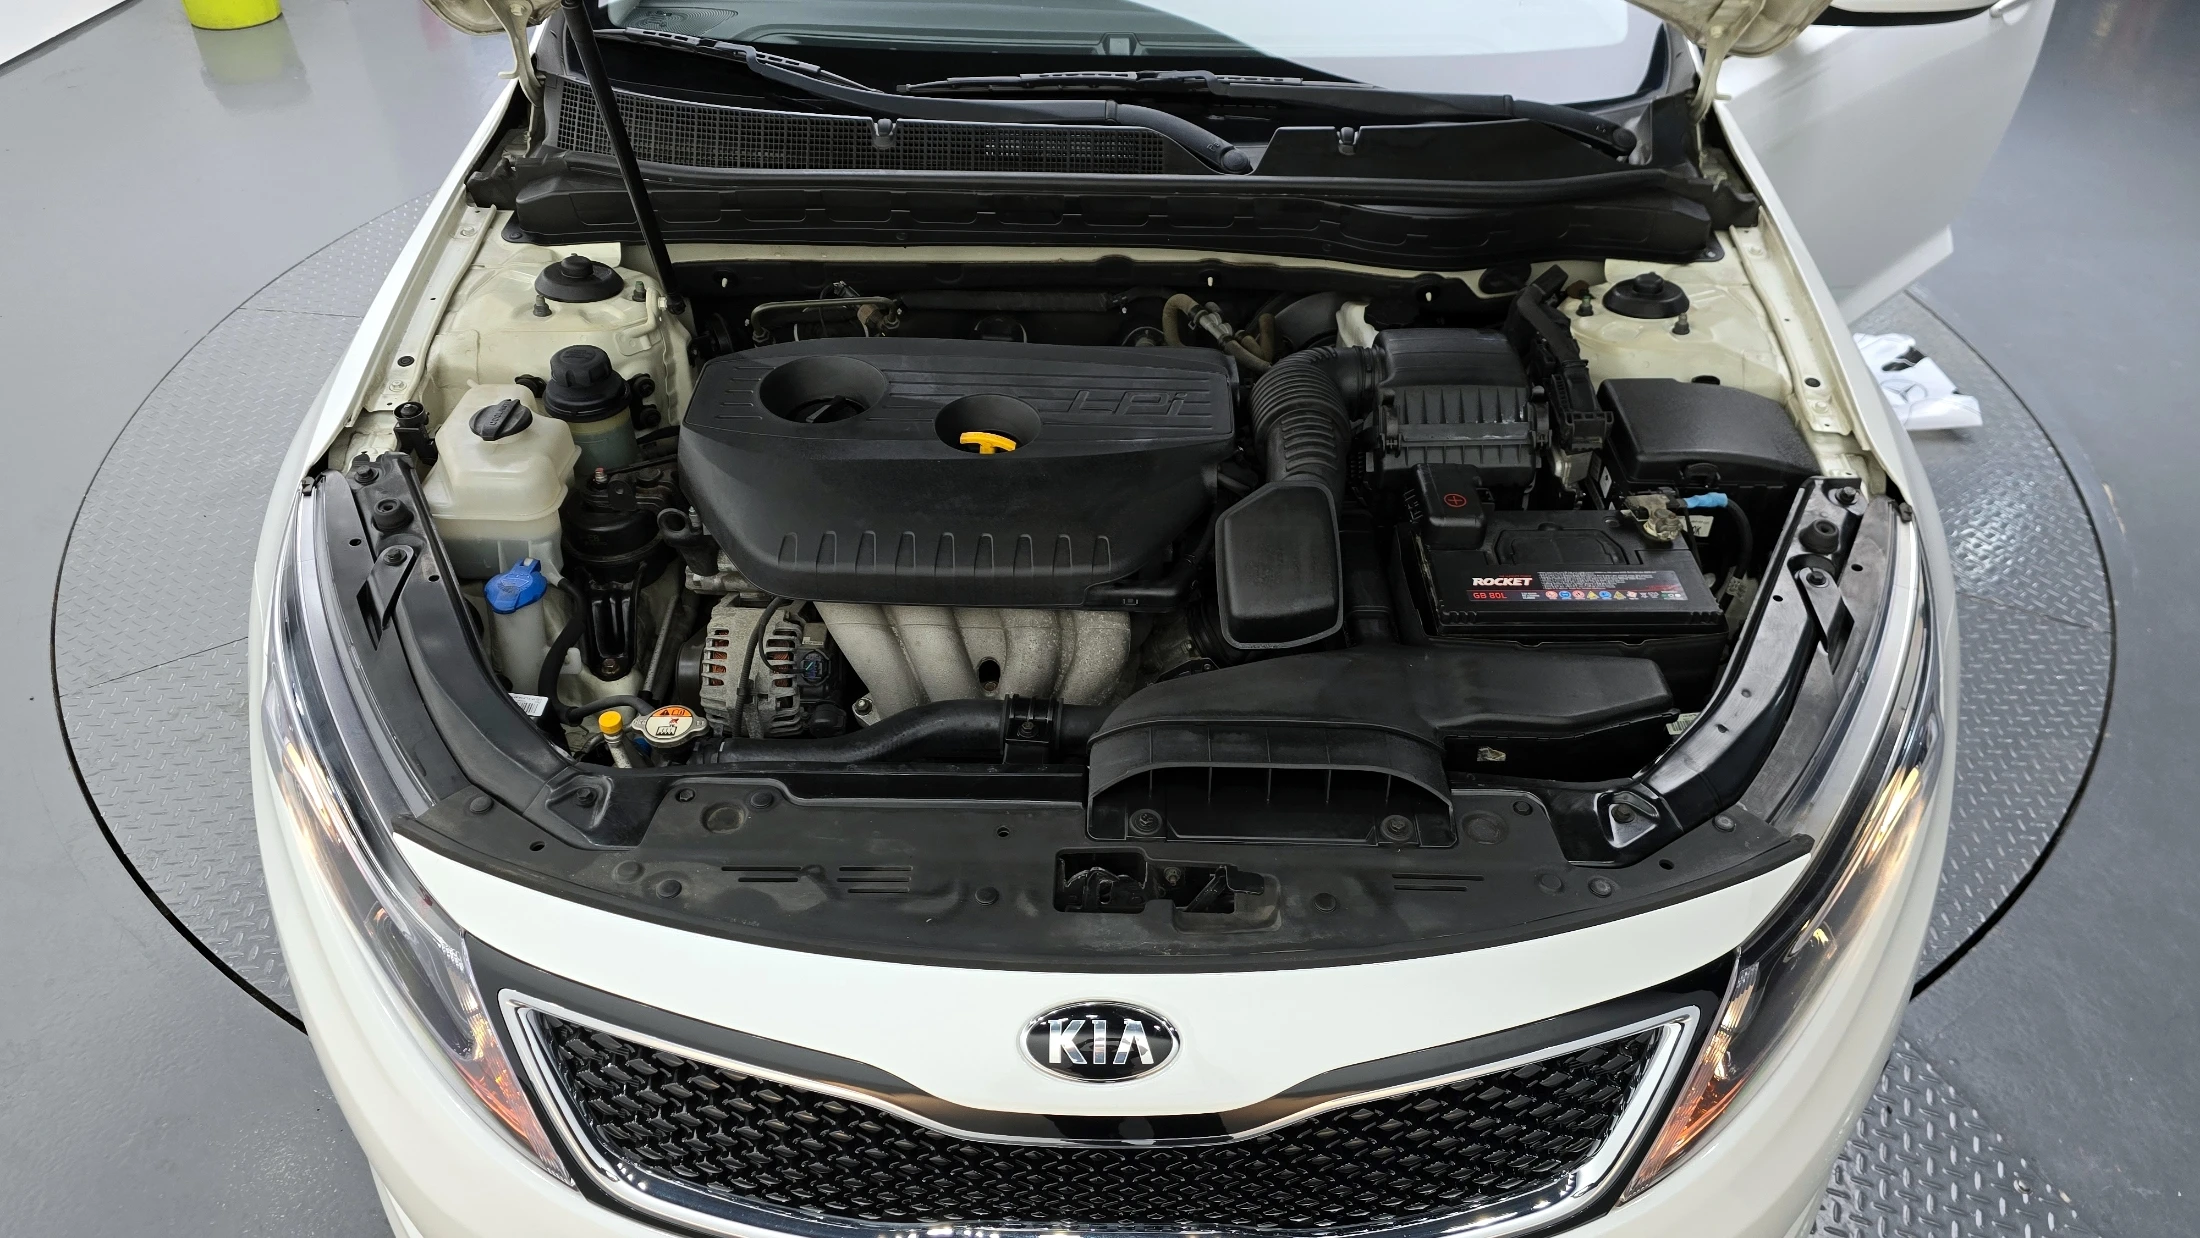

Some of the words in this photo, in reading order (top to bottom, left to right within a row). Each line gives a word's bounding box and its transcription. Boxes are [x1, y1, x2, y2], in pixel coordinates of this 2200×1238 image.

[1067, 390, 1188, 416] LPi
[1472, 577, 1533, 586] ROCKET
[1048, 1019, 1155, 1065] KIA
